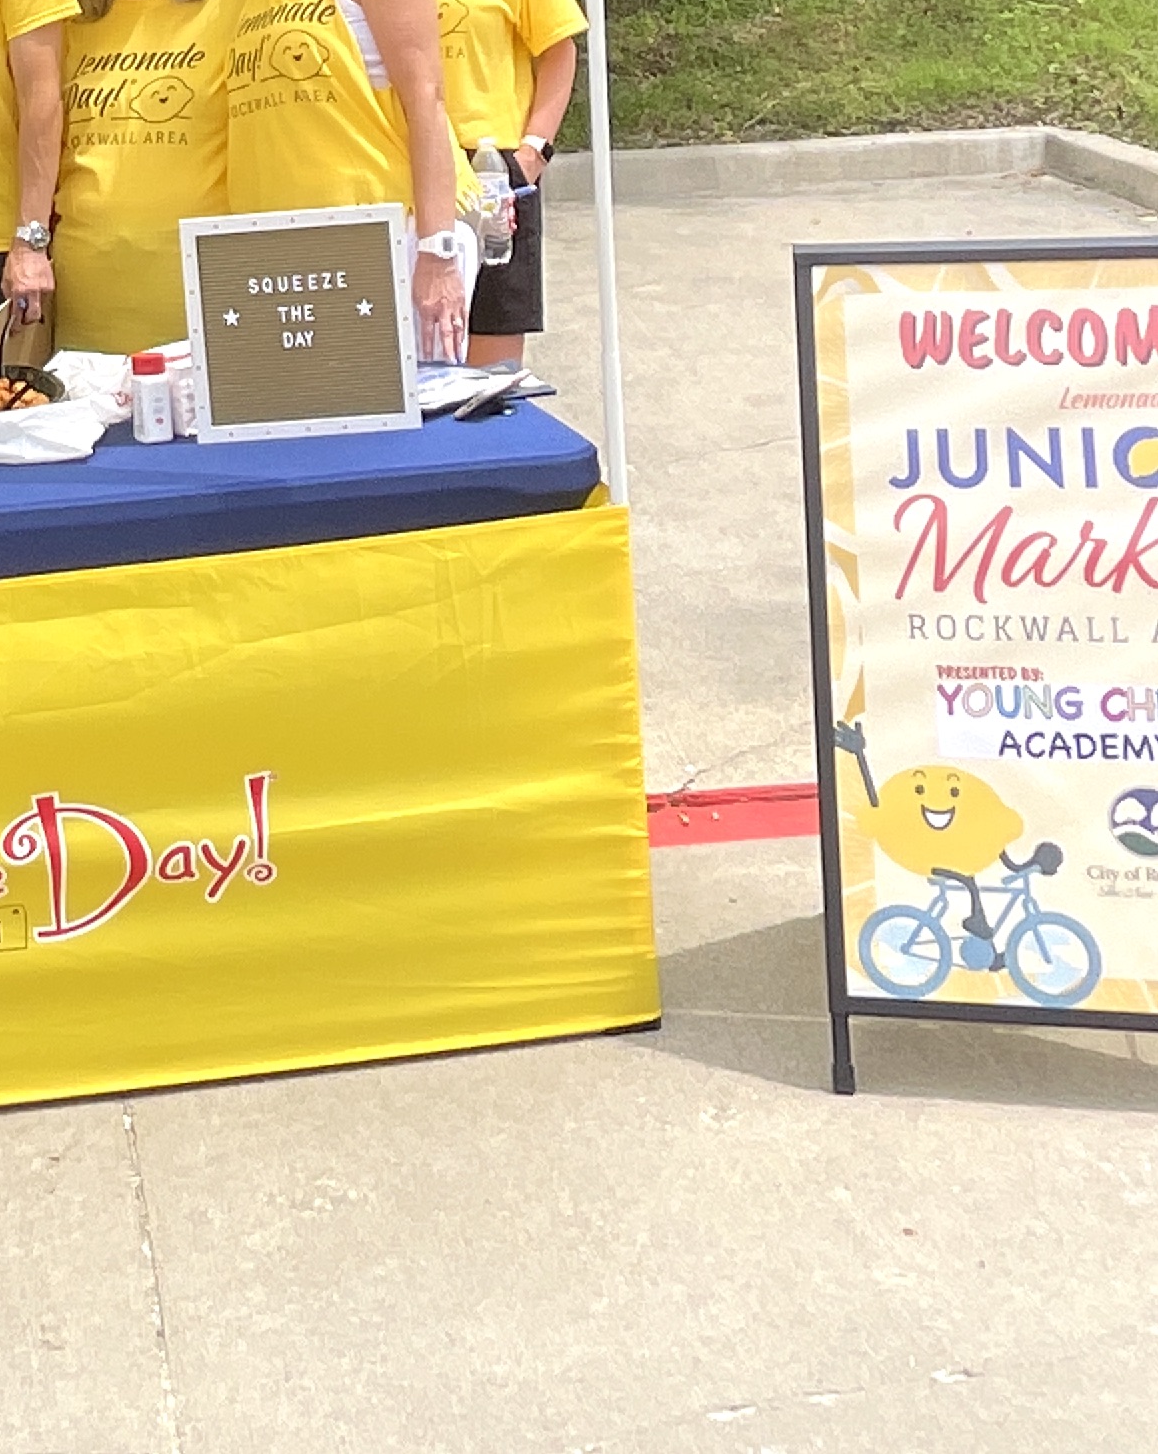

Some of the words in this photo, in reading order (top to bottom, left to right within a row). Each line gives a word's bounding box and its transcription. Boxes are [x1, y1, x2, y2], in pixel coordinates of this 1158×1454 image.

[71, 42, 206, 81] Lemonade
[143, 130, 189, 146] AREA
[248, 271, 348, 294] SQUEEZE
[277, 304, 316, 323] THE
[282, 330, 315, 349] DAY
[907, 613, 1129, 644] ROCKWALL
[935, 664, 1018, 682] PRESENTED
[936, 682, 1085, 722] YOUNG
[1100, 686, 1158, 723] CH
[0, 772, 277, 941] Day!
